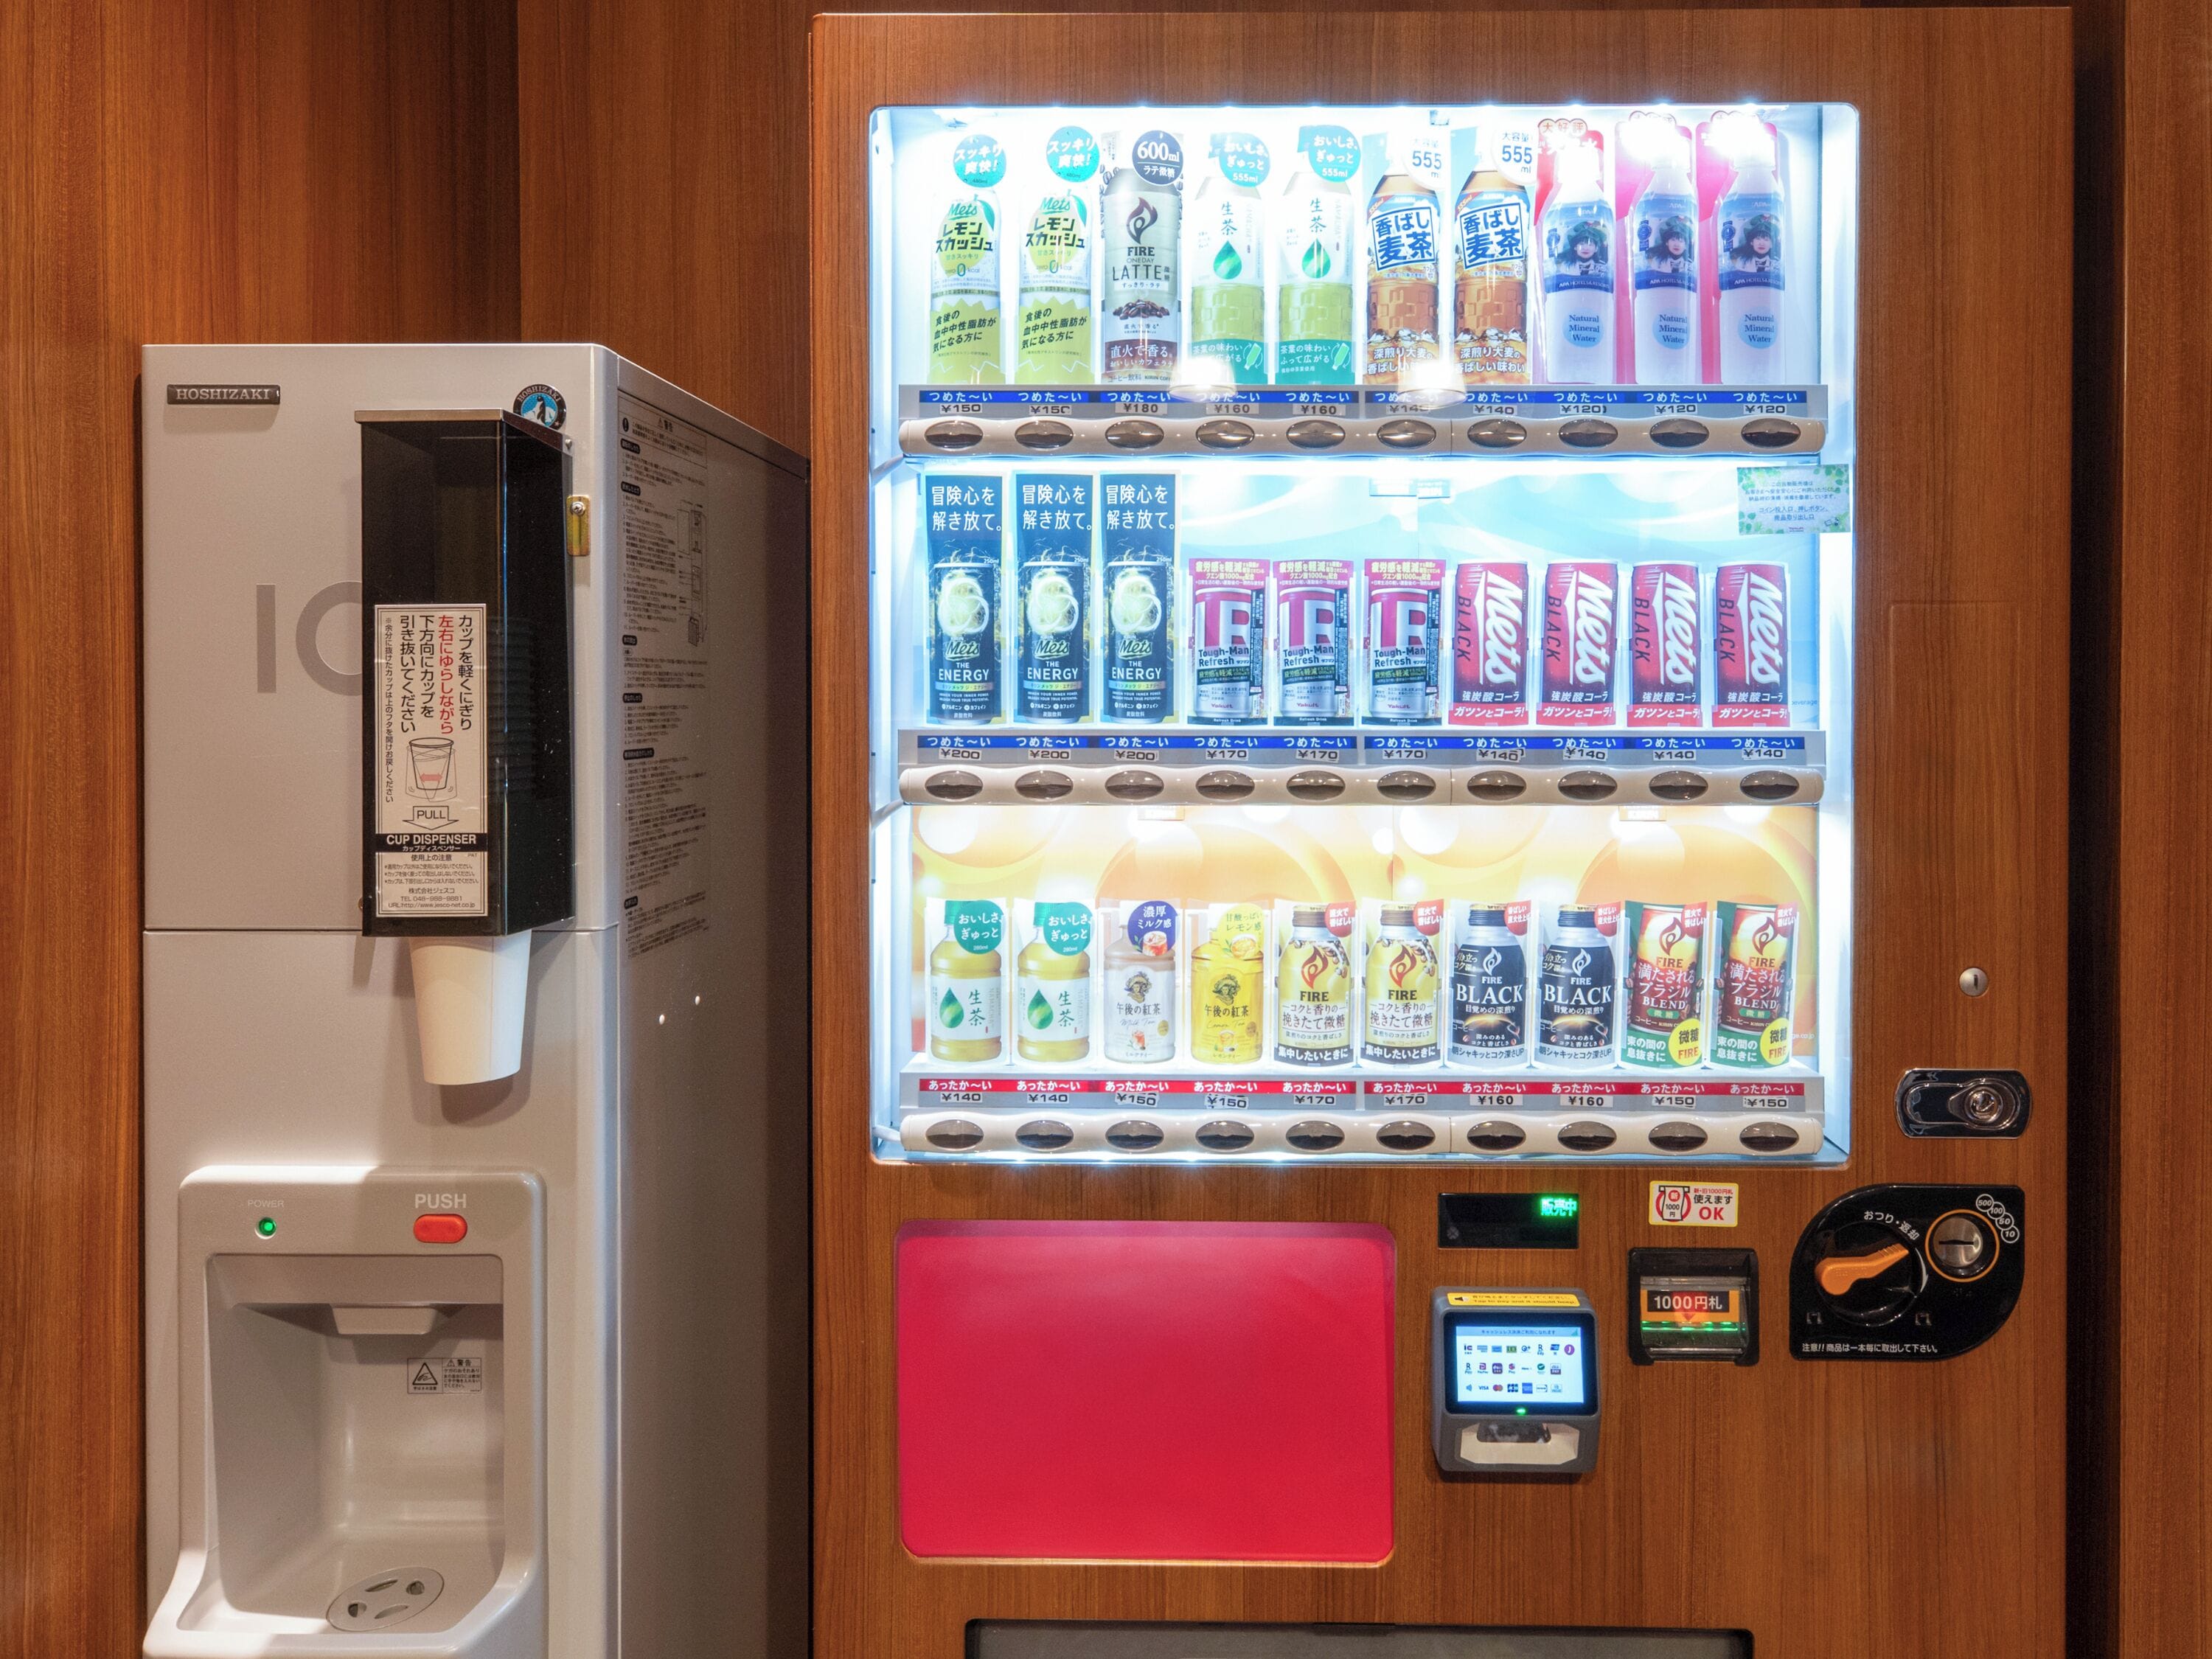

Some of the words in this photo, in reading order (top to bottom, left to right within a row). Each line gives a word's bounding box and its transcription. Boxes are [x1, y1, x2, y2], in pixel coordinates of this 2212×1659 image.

[1502, 132, 1530, 143] 大容量
[1047, 137, 1096, 154] スッキリ
[1137, 141, 1180, 162] 600ml
[1502, 145, 1532, 164] 555
[1144, 165, 1176, 178] ラテ微糖
[1322, 168, 1348, 178] 555ml
[1520, 165, 1531, 174] ml
[1034, 217, 1076, 232] レモン
[1375, 212, 1430, 238] 香ばし
[1463, 208, 1519, 236] 香ばし
[943, 222, 983, 237] レモン
[936, 237, 994, 254] スカッシュ
[1026, 232, 1086, 249] スカッシュ
[1464, 228, 1523, 265] 麦茶
[1377, 231, 1433, 265] 麦茶
[1113, 264, 1162, 281] LATTE
[935, 310, 960, 327] 食後の
[1569, 314, 1599, 323] Natural
[933, 317, 997, 339] 血中中性脂肪が
[1569, 324, 1601, 333] Mineral
[933, 332, 983, 353] 気になる方に
[1572, 334, 1597, 343] Water
[1280, 344, 1331, 355] 茶葉の味わい
[1460, 347, 1520, 360] 深煎り大麦の
[1280, 354, 1330, 365] ふって広がる
[176, 389, 271, 400] HOSHIZAKI
[517, 386, 561, 403] HOSHIZAKI
[941, 404, 981, 413] ¥150
[1123, 403, 1158, 413] ¥180
[1214, 404, 1250, 414] ¥160
[1301, 405, 1336, 414] ¥160
[1474, 406, 1514, 414] ¥140
[1655, 405, 1696, 414] ¥120
[1745, 405, 1785, 414] ¥120
[932, 486, 995, 507] 冒険心を
[1023, 484, 1086, 505] 冒険心を
[932, 510, 1002, 532] 解き放て。
[1023, 509, 1092, 531] 解き放て。
[945, 640, 979, 660] Mets
[1198, 646, 1249, 658] Tough-Man
[420, 614, 435, 718] 下方向にカップを
[1199, 657, 1234, 667] Refresh
[1284, 655, 1318, 667] Refresh
[400, 614, 415, 733] 引き抜いてください
[438, 614, 454, 734] 左右にゆらしながら
[458, 614, 474, 731] カップを軽くにぎり
[939, 668, 990, 682] ENERGY
[1027, 667, 1078, 681] ENERGY
[1462, 691, 1520, 703] 強炭酸コーラ
[1551, 691, 1608, 703] 強炭酸コーラ
[1454, 706, 1525, 718] ガツンとコーラ!
[940, 748, 979, 759] ¥200
[1029, 750, 1069, 759] ¥200
[1206, 750, 1247, 759] ¥170
[1298, 750, 1338, 759] ¥170
[1655, 751, 1694, 760] ¥140
[1744, 748, 1783, 758] ¥140
[417, 810, 446, 820] PULL
[386, 835, 410, 845] CUP
[413, 834, 477, 844] DISPENSER
[1143, 905, 1166, 917] 濃厚
[1226, 912, 1262, 922] 甘酸っぱい
[1137, 918, 1172, 929] ミルク感
[1226, 923, 1262, 932] レモン感
[961, 928, 999, 940] ぎゅっと
[1638, 963, 1695, 984] 満たされる
[1300, 991, 1329, 1002] FIRE
[1388, 990, 1417, 1001] FIRE
[1456, 984, 1523, 1005] BLACK
[1544, 984, 1612, 1006] BLACK
[1639, 982, 1691, 999] ブラジル
[968, 990, 986, 1026] 生茶
[1642, 996, 1686, 1009] BLEND
[1734, 996, 1777, 1009] BLEND
[1116, 1002, 1161, 1016] 午後の紅茶
[1205, 1004, 1249, 1018] 午後の紅茶
[1290, 1004, 1338, 1015] コクと香りの
[1465, 1004, 1515, 1014] 目覚めの深煎り
[1283, 1012, 1346, 1029] 挽きたて微糖
[1370, 1010, 1433, 1029] 挽きたて微糖
[1679, 1029, 1699, 1045] 微糖
[1278, 1047, 1349, 1061] 集中したいときに
[1627, 1048, 1666, 1062] 息抜きに
[942, 1093, 981, 1102] ¥140
[1029, 1094, 1068, 1102] ¥140
[1295, 1096, 1335, 1104] ¥170
[1478, 1096, 1513, 1105] ¥160
[1568, 1096, 1604, 1106] ¥160
[1655, 1096, 1694, 1105] ¥150
[247, 1199, 285, 1208] POWER
[415, 1193, 467, 1208] PUSH
[1694, 1194, 1733, 1204] 使えます
[1699, 1206, 1724, 1220] OK
[1863, 1210, 1920, 1241] おつり・返却
[1655, 1295, 1722, 1310] 1000円札
[1802, 1343, 1825, 1352] 注意!!
[1826, 1343, 1938, 1353] 商品は一本毎に取出して下さい。
